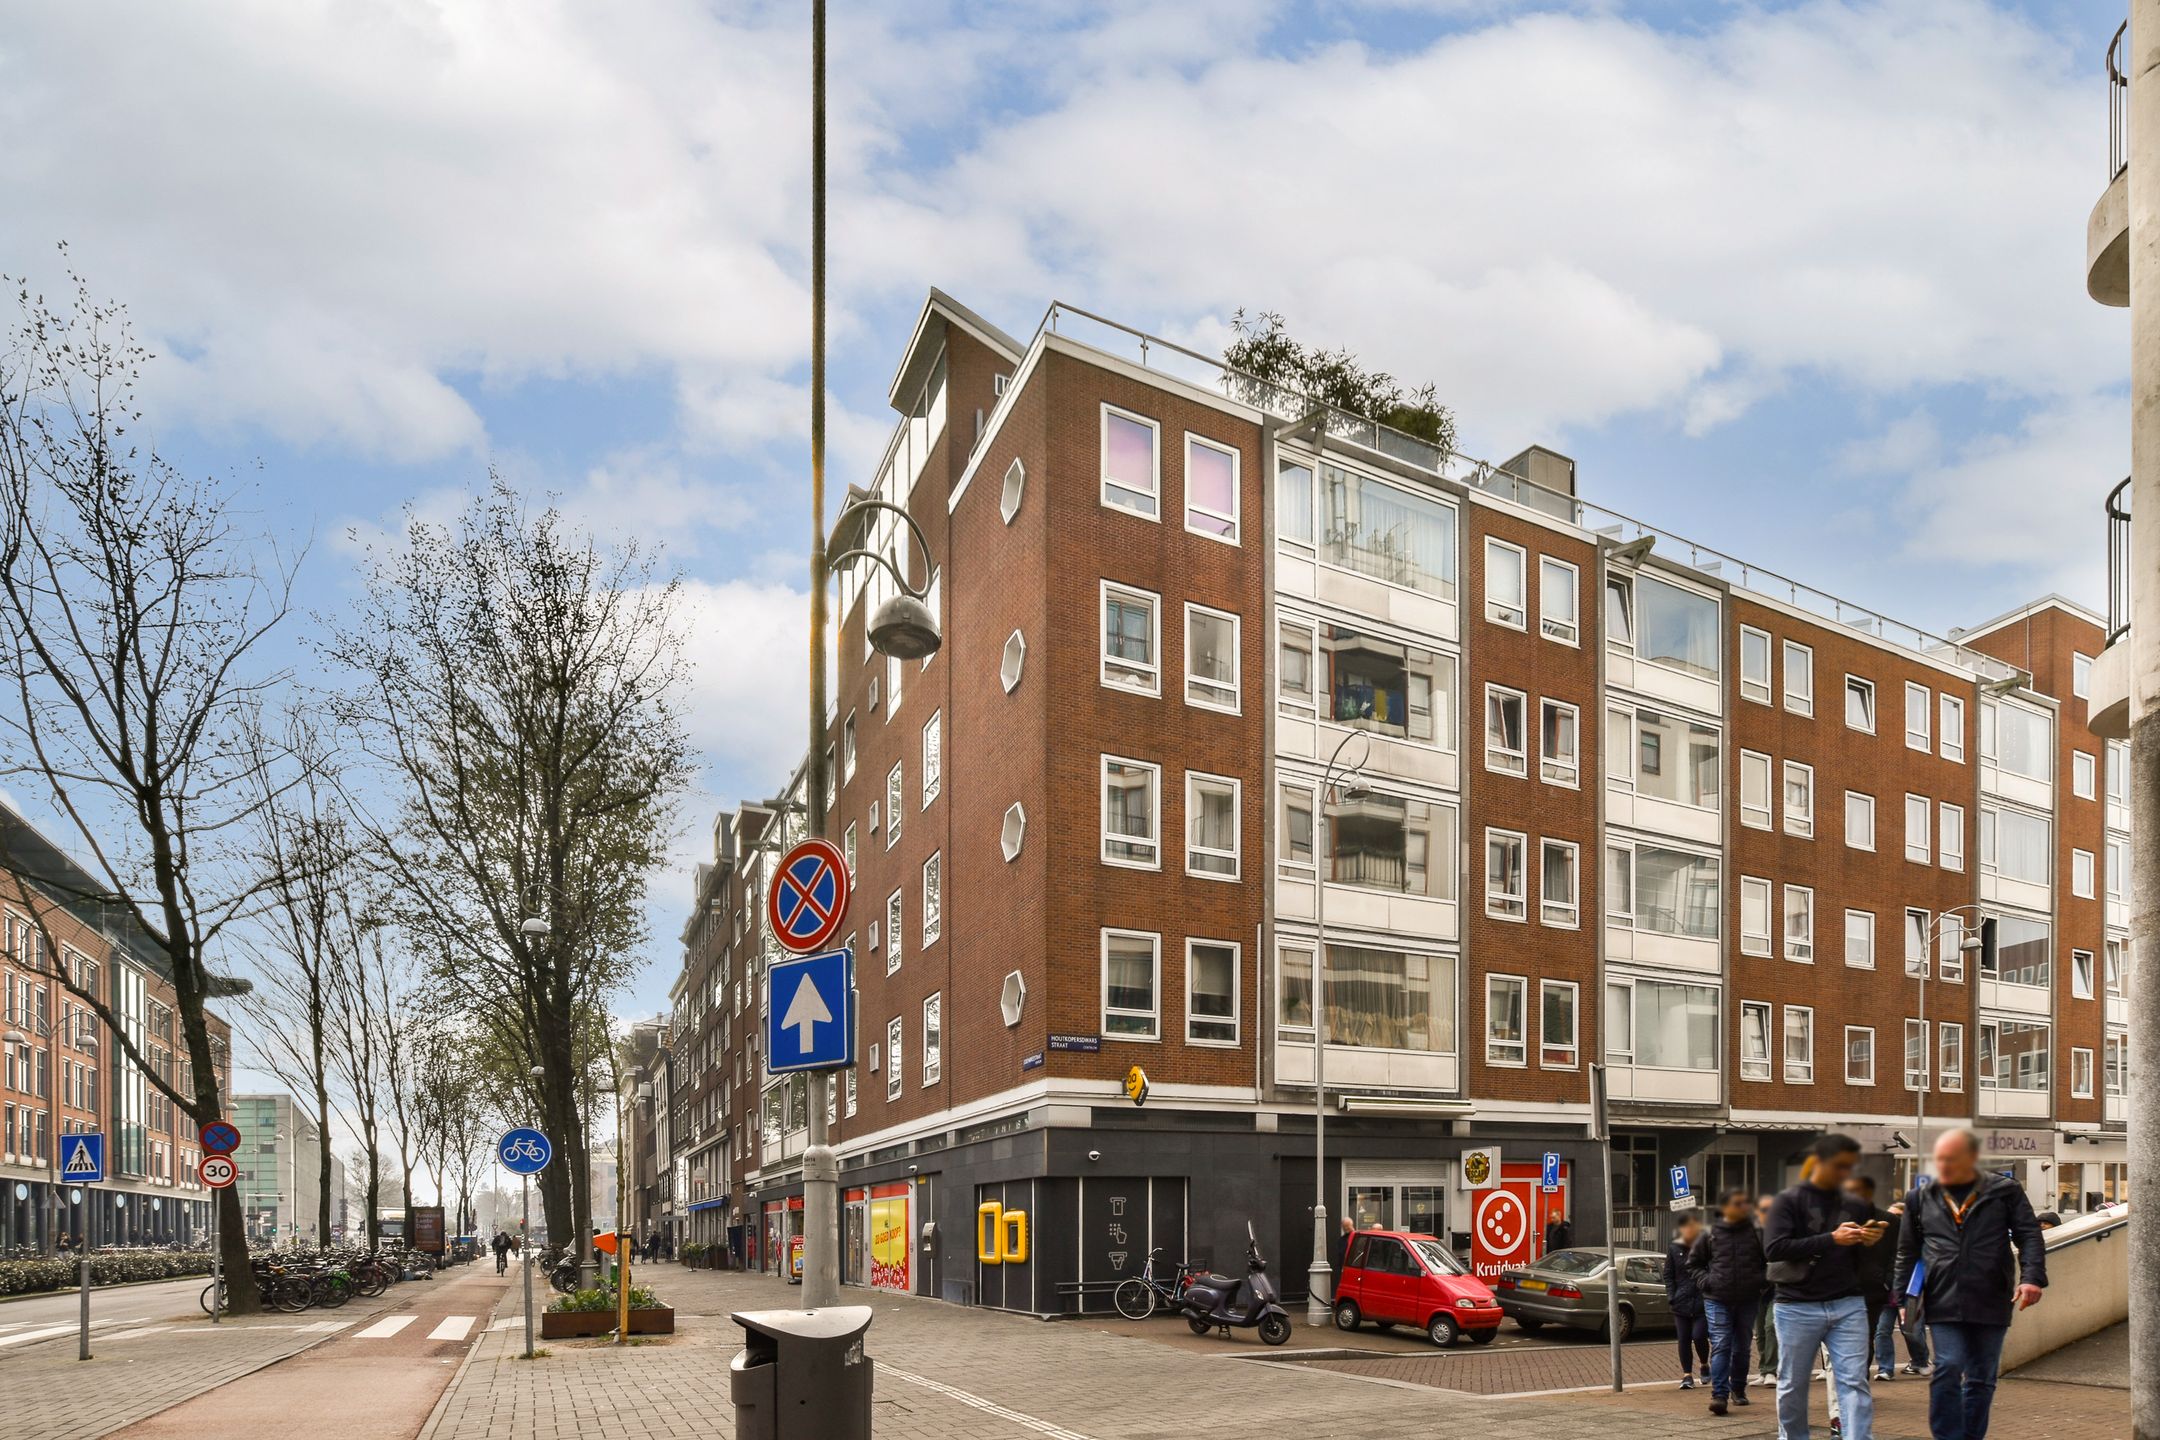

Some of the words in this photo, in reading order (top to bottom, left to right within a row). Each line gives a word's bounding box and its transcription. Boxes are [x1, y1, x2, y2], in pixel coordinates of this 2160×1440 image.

[1051, 1035, 1098, 1044] HOUTKOPERSDWARS
[1547, 1156, 1556, 1172] P
[206, 1165, 230, 1178] 30
[1674, 1170, 1684, 1185] P
